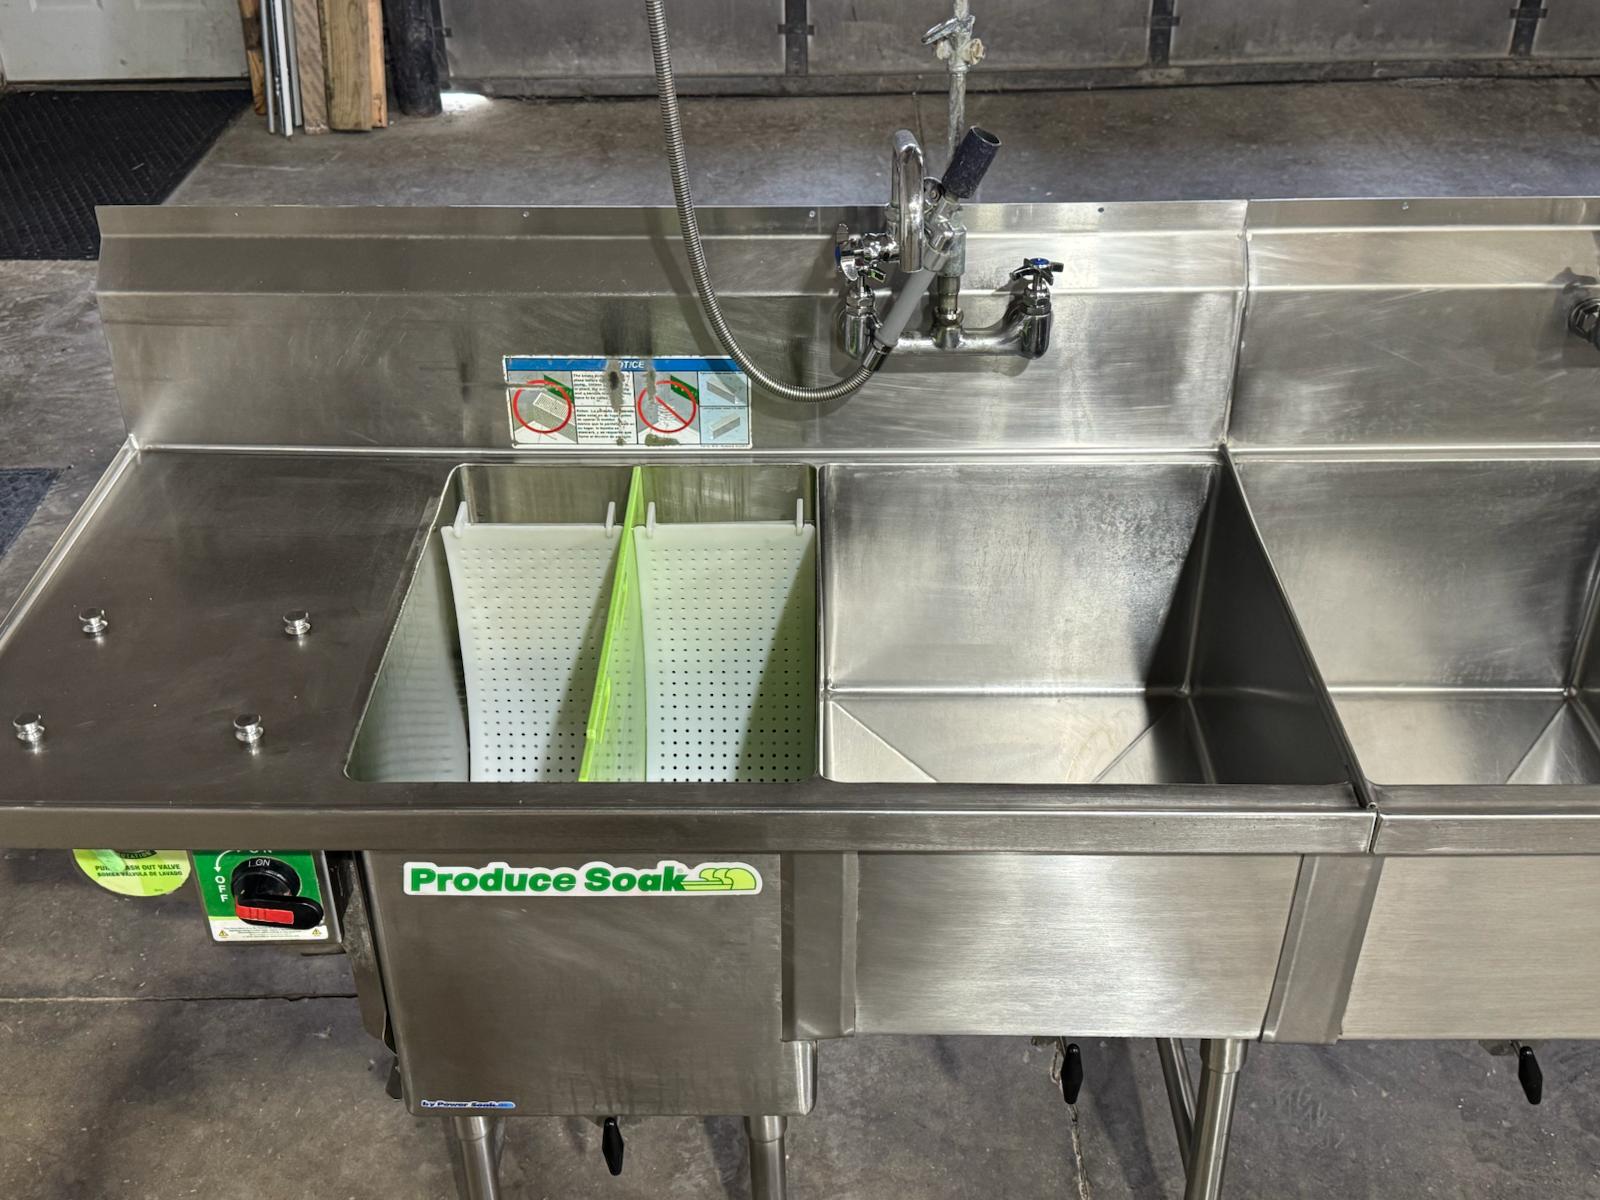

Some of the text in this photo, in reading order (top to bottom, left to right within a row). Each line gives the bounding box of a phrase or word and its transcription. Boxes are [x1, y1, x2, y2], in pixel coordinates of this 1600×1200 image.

[215, 875, 229, 903] OFF
[411, 866, 688, 892] Produce Soak
